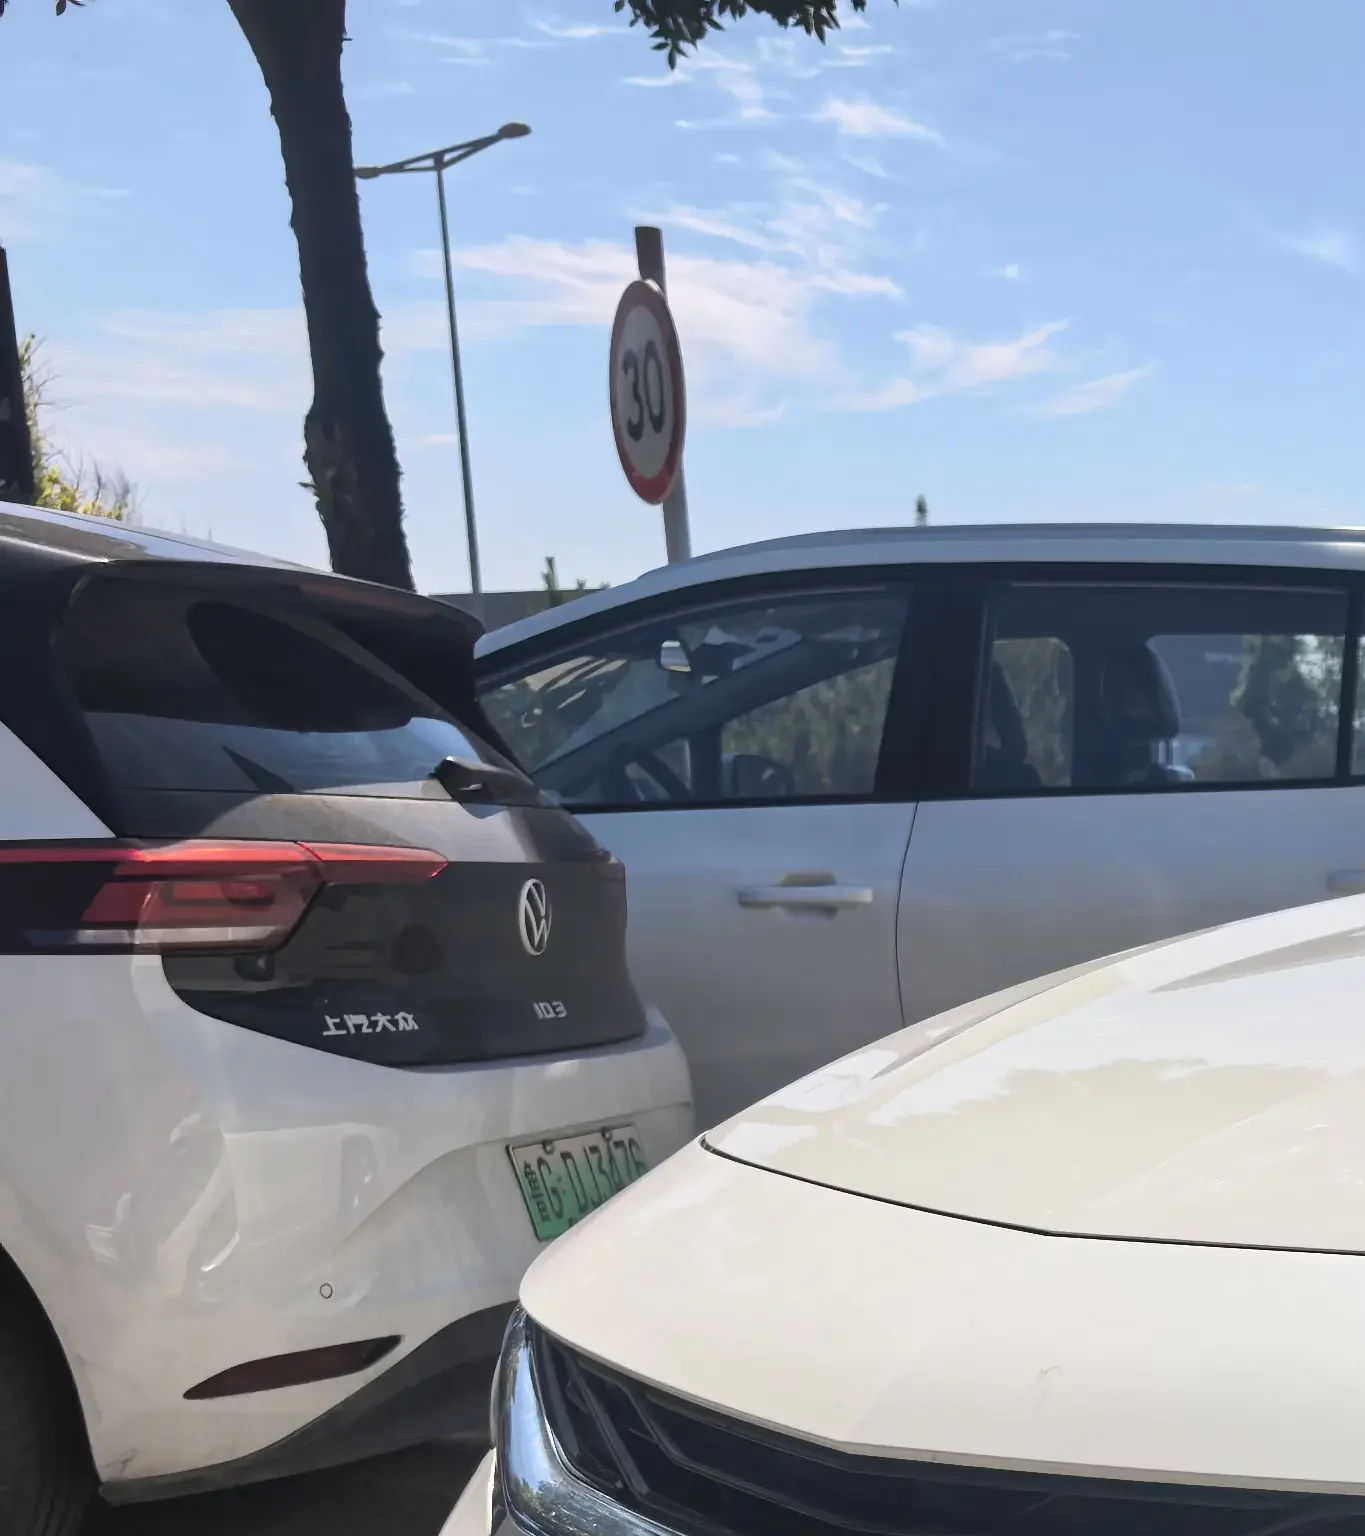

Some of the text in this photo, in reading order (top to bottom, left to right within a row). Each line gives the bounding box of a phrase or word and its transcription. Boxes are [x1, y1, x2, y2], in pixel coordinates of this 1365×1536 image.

[622, 340, 665, 442] 30
[322, 1011, 420, 1037] 上汽大众
